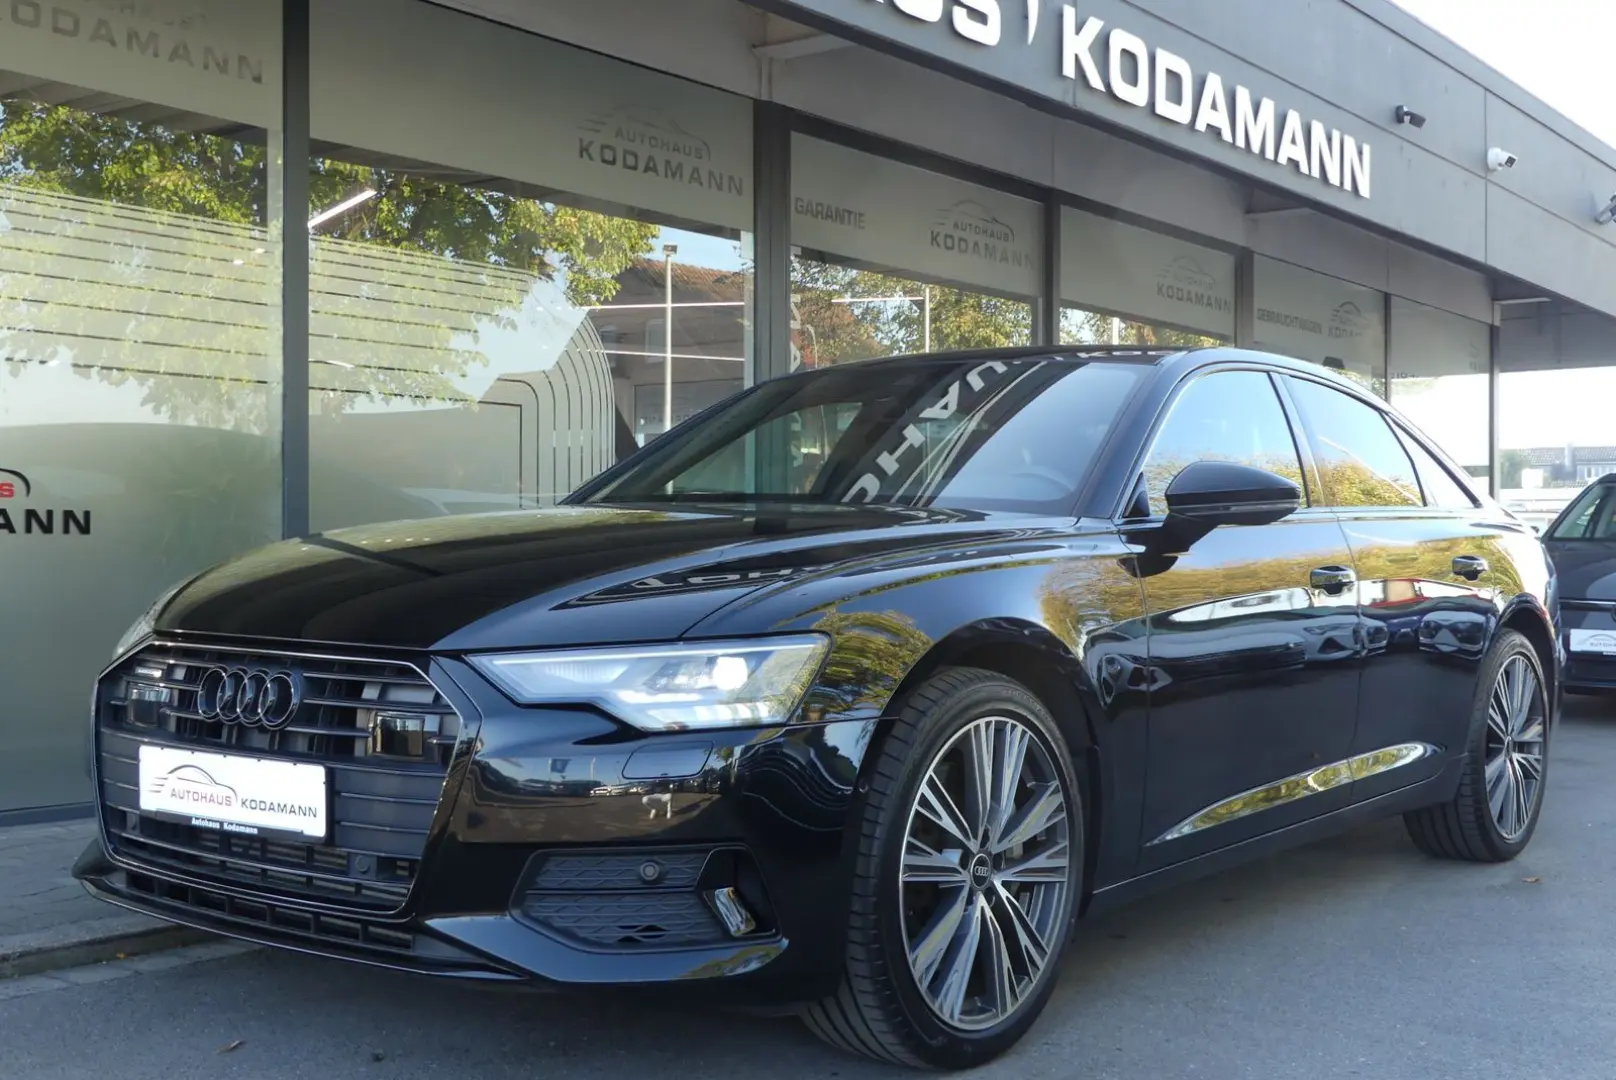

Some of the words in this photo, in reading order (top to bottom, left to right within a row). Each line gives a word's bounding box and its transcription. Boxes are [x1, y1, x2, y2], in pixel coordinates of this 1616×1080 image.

[1060, 5, 1371, 200] KODAMANN
[615, 127, 703, 159] AUTOHAUS
[578, 137, 744, 197] KODAMANN
[794, 197, 866, 230] GARANTIE
[930, 229, 1034, 271] KODAMANN
[1156, 281, 1232, 315] KODAMANN
[170, 787, 232, 807] AUTOHAUS
[240, 798, 318, 818] KODAMANN
[191, 817, 220, 831] Autohaus
[223, 822, 258, 835] Kodamann
